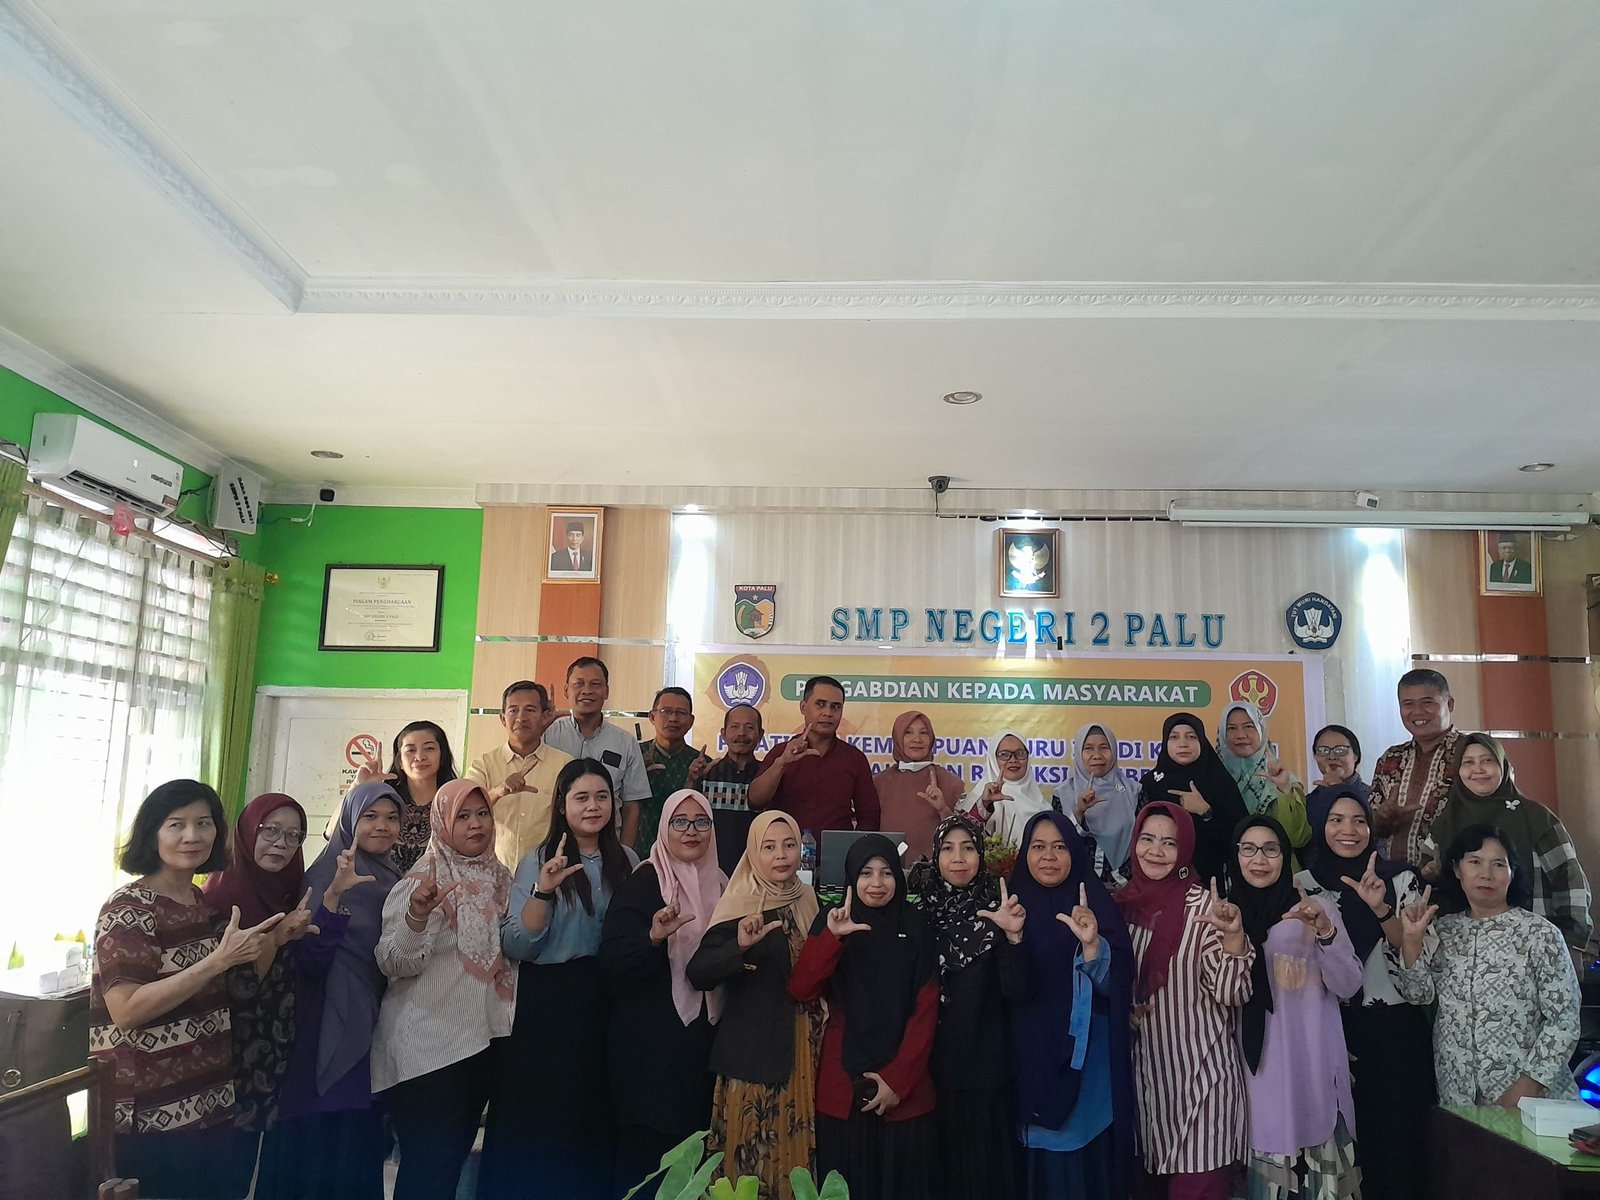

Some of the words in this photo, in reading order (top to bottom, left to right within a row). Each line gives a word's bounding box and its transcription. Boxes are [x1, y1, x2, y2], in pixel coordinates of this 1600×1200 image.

[830, 606, 910, 642] SMP
[924, 608, 1076, 646] NEGERI
[1090, 611, 1111, 646] 2
[1124, 612, 1226, 649] PALU
[795, 679, 939, 698] PGABDIAN
[947, 682, 1035, 700] KEPADA
[1043, 684, 1199, 703] MASYARAKAT
[847, 737, 988, 756] KEMPUAN
